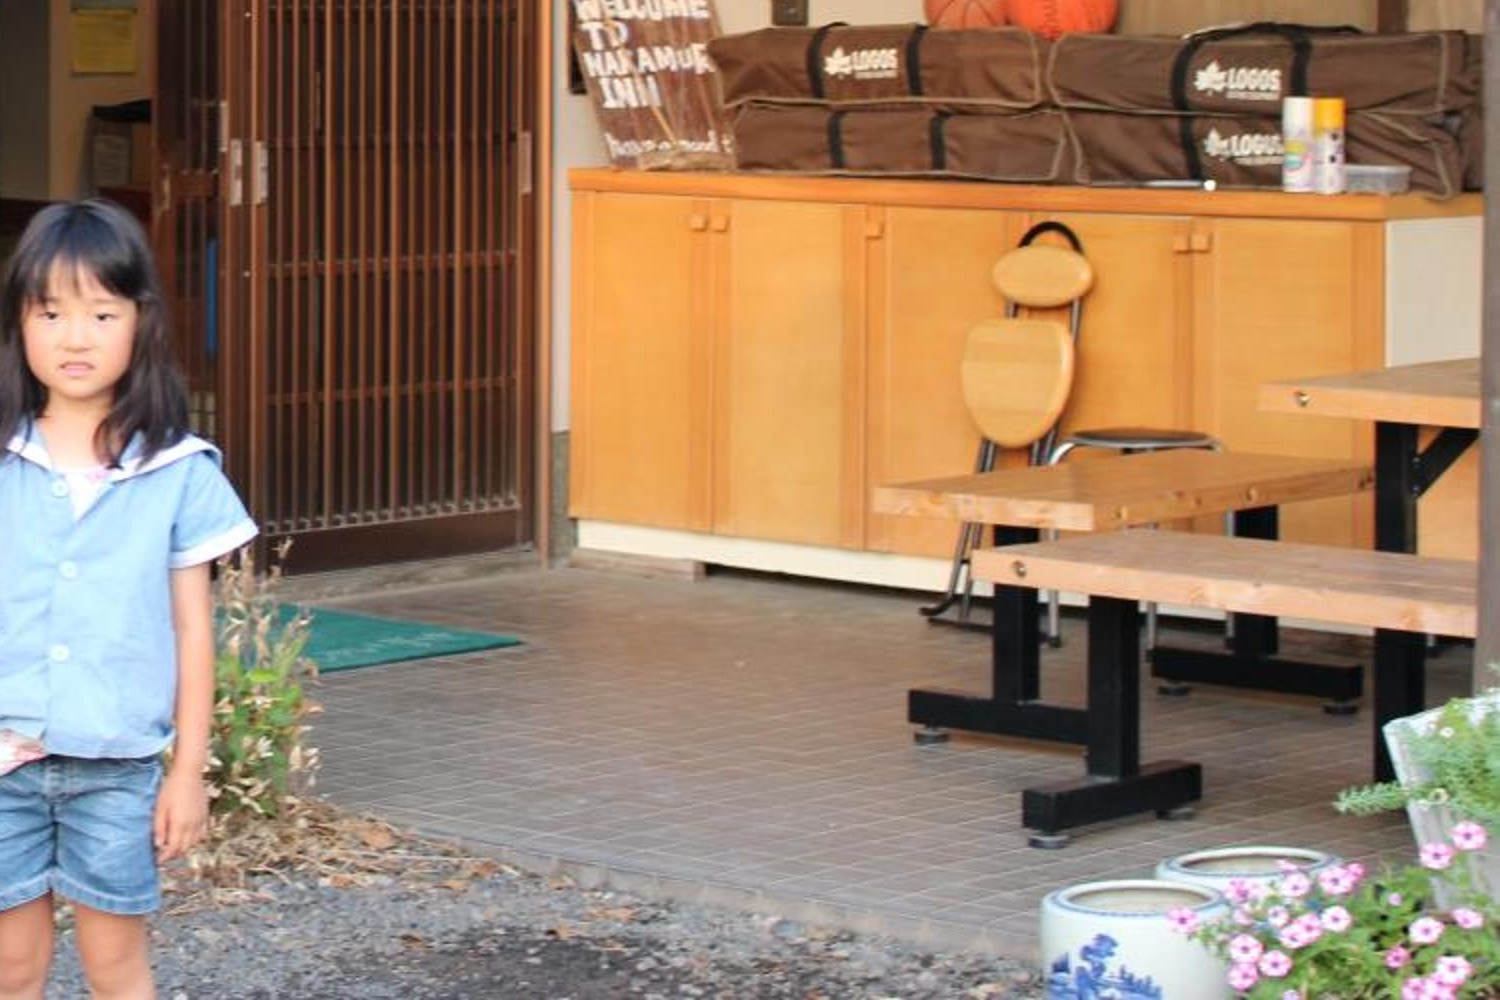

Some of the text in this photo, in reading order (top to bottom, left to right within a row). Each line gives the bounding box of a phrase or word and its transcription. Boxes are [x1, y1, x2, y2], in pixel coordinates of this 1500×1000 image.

[851, 48, 899, 71] LOGOS
[1227, 67, 1282, 91] LOGOS
[1230, 133, 1284, 157] LOGOS
